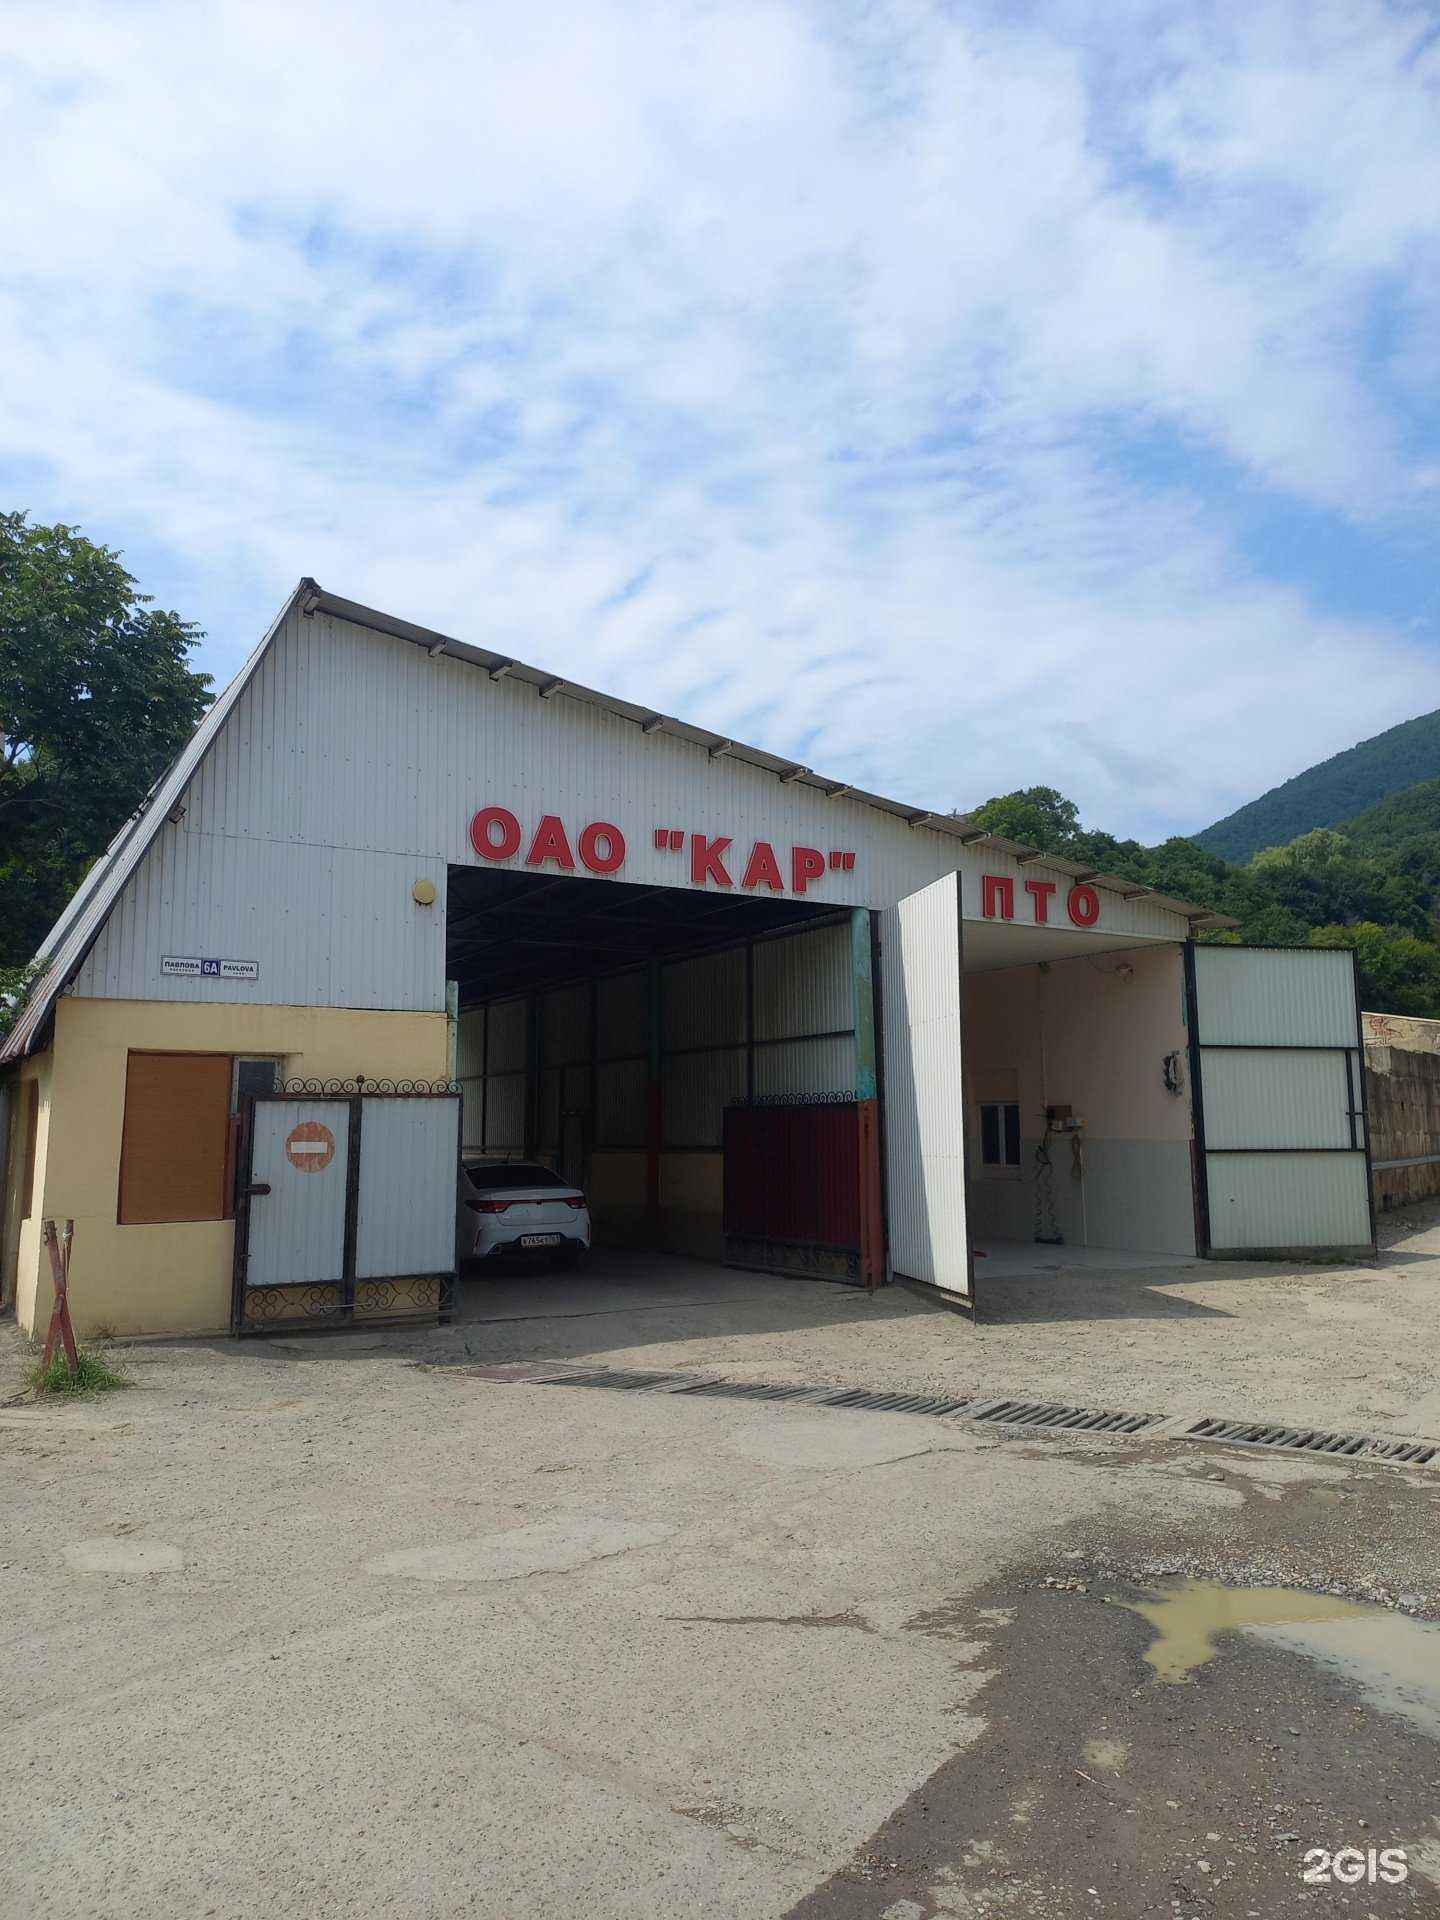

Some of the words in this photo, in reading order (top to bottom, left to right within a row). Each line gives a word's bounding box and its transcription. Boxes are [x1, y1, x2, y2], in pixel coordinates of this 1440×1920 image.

[470, 806, 627, 874] ОАО
[653, 829, 856, 894] "КАР"
[983, 875, 1100, 928] ПТО
[164, 961, 200, 969] ПАВЛОВА
[223, 964, 255, 973] PAVLOVA
